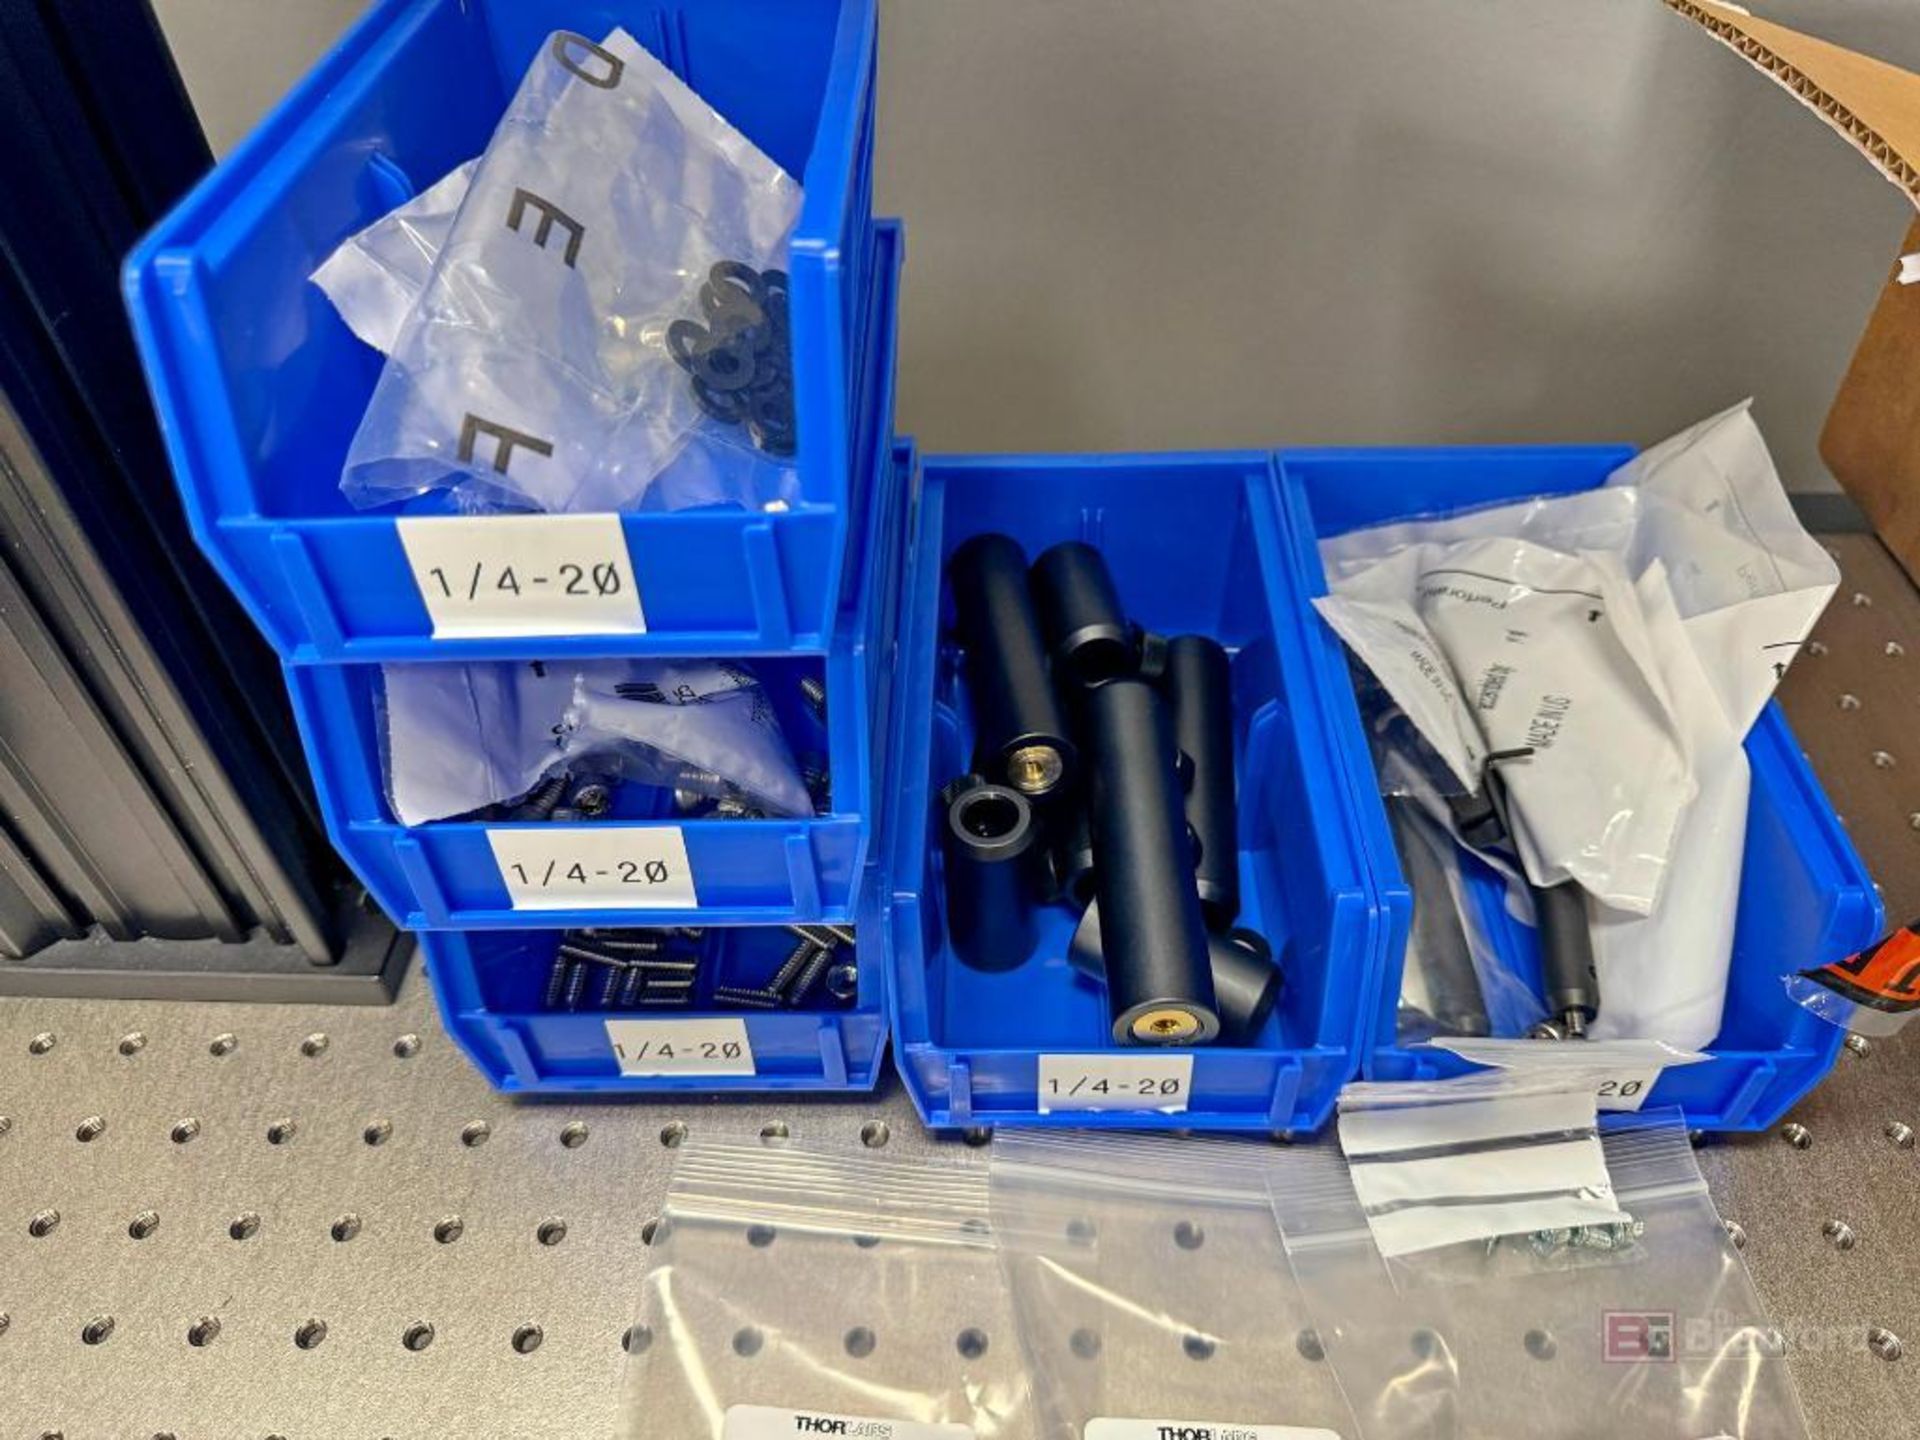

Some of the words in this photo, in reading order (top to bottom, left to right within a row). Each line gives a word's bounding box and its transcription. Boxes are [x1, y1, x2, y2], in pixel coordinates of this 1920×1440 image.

[430, 561, 622, 600] 1/4-20
[510, 859, 669, 887] 1/4-20
[613, 1040, 742, 1062] 1/4-20
[1048, 1075, 1180, 1097] 1/4-20
